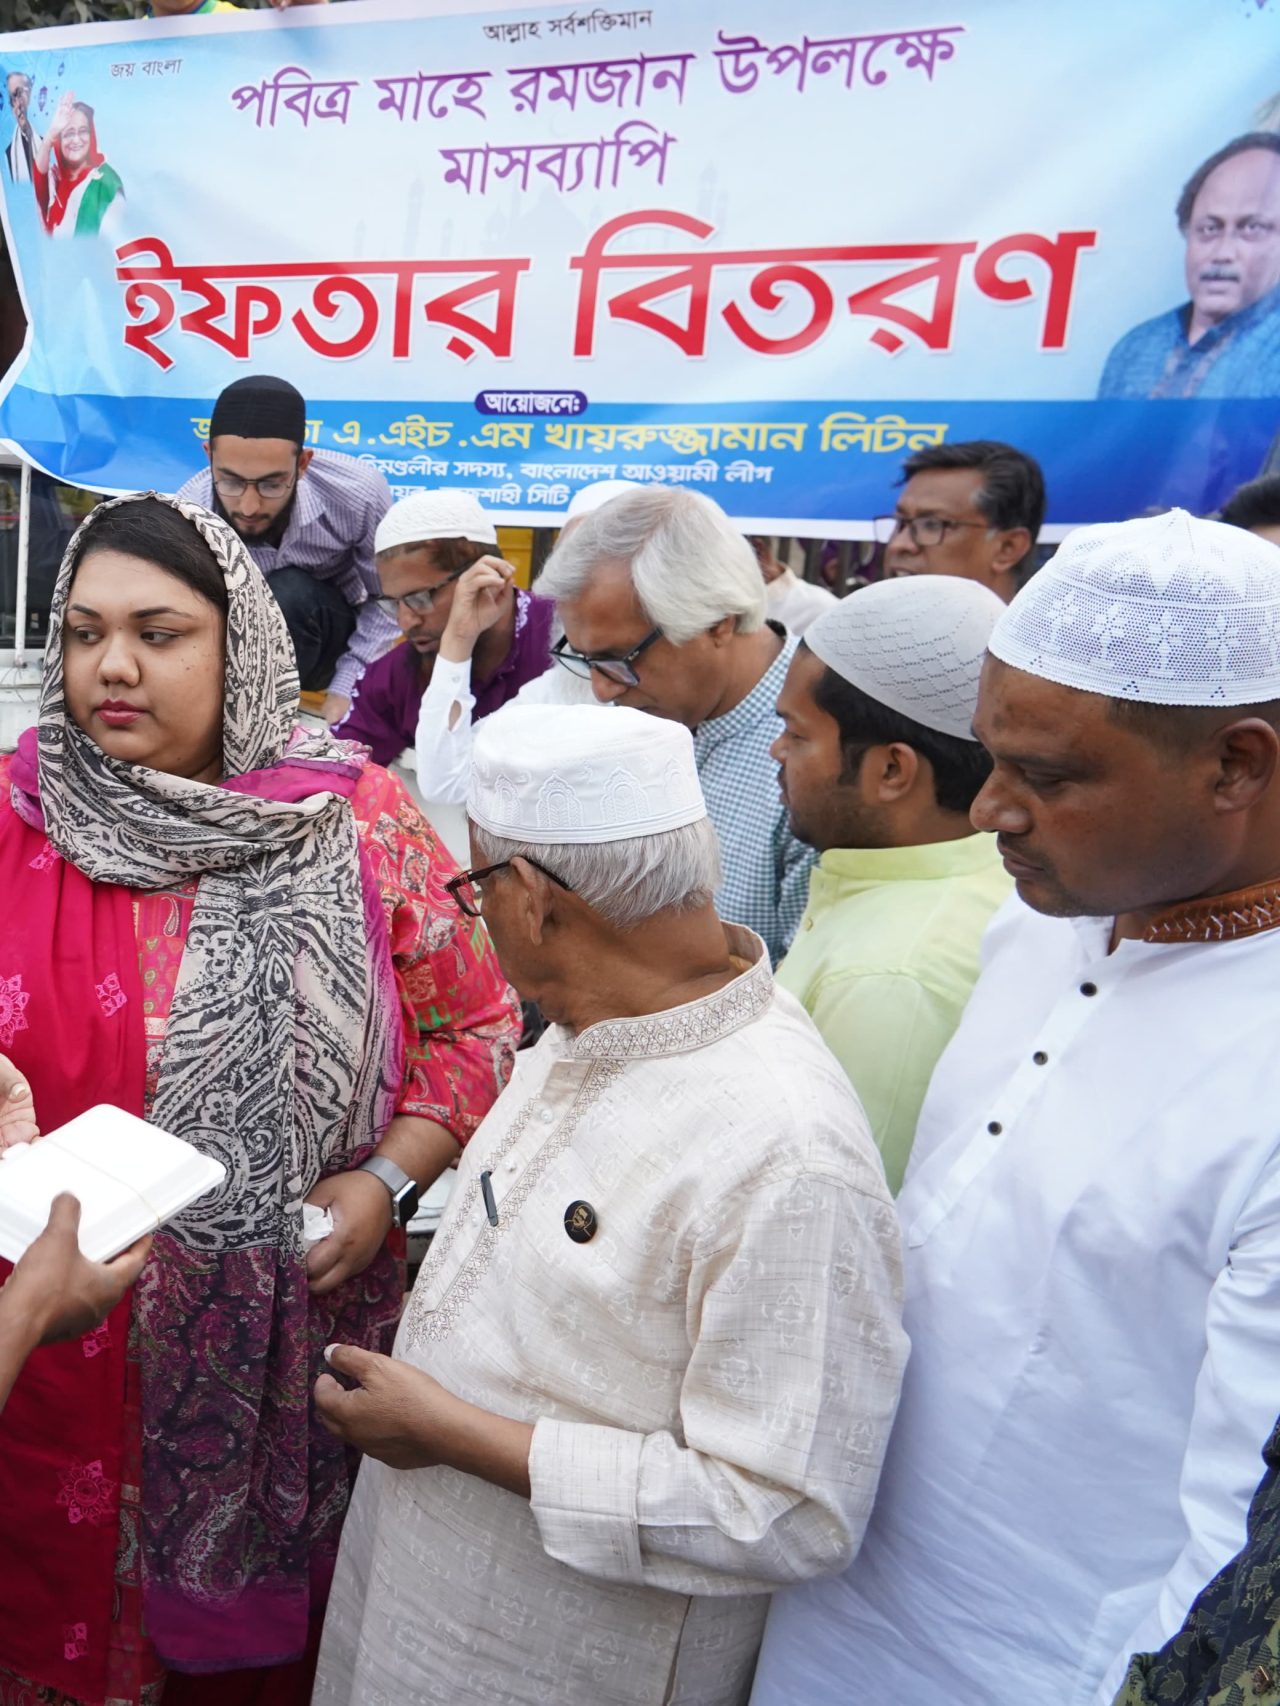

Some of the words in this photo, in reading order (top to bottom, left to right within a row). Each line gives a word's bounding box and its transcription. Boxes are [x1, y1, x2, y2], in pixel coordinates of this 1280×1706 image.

[483, 21, 541, 43] আল্লাহ
[548, 10, 653, 40] সর্বশক্তিমান
[110, 62, 135, 78] জয়
[142, 57, 183, 77] বাংলা
[231, 66, 360, 128] পবিত্র
[373, 70, 493, 122] মাহে
[506, 52, 697, 114] রমজান
[713, 26, 965, 94] উপলক্ষে
[438, 119, 677, 195] মাসব্যাপি
[116, 237, 531, 370] ইফতার
[570, 209, 1097, 357] বিতরণ
[544, 423, 808, 455] খায়রুজ্জামান
[819, 412, 950, 454] লিটন
[520, 462, 617, 482] বাংলাদেশ
[621, 454, 720, 484] আওয়ামী
[724, 459, 773, 484] লীগ
[527, 484, 571, 506] সিটি
